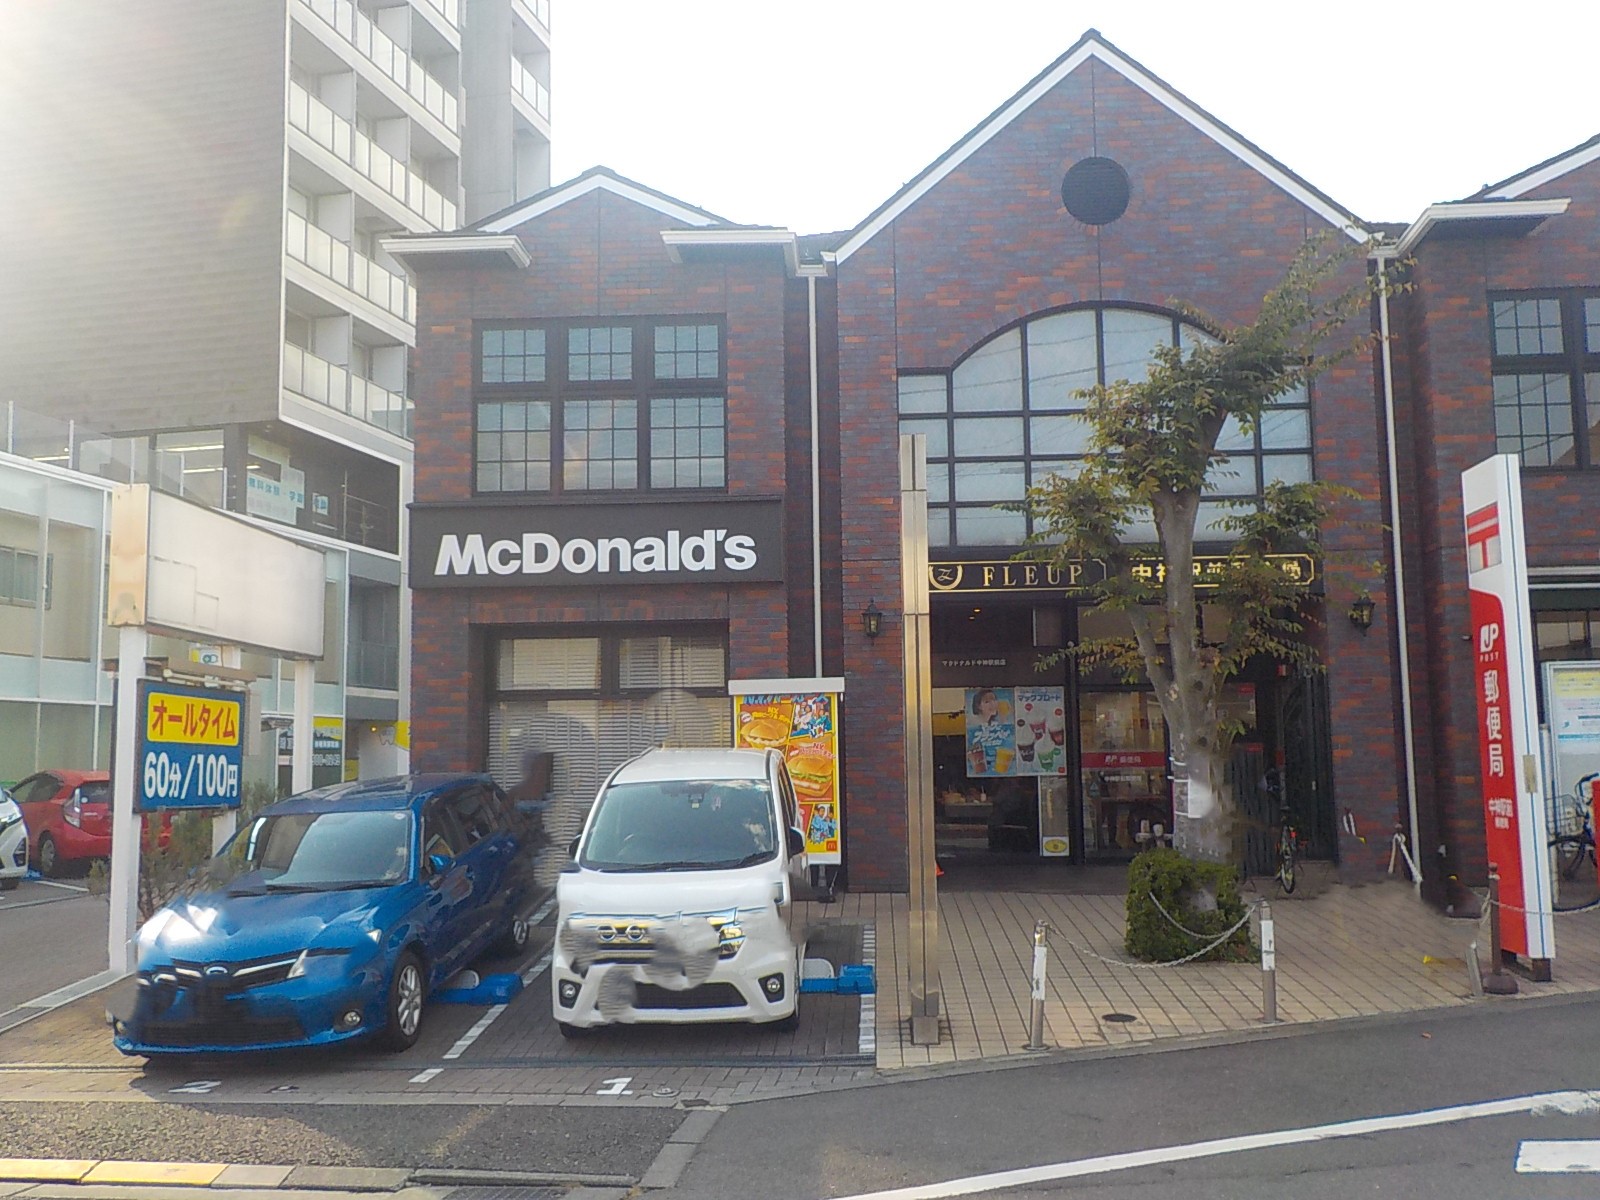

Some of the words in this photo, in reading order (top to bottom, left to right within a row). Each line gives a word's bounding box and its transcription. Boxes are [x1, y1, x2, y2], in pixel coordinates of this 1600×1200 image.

[434, 529, 758, 576] McDonald's
[982, 564, 1083, 587] FLEUP
[152, 700, 235, 740] オールタイム
[1483, 669, 1504, 777] 郵便局
[144, 751, 238, 799] 60分/100円
[596, 1076, 633, 1095] 1
